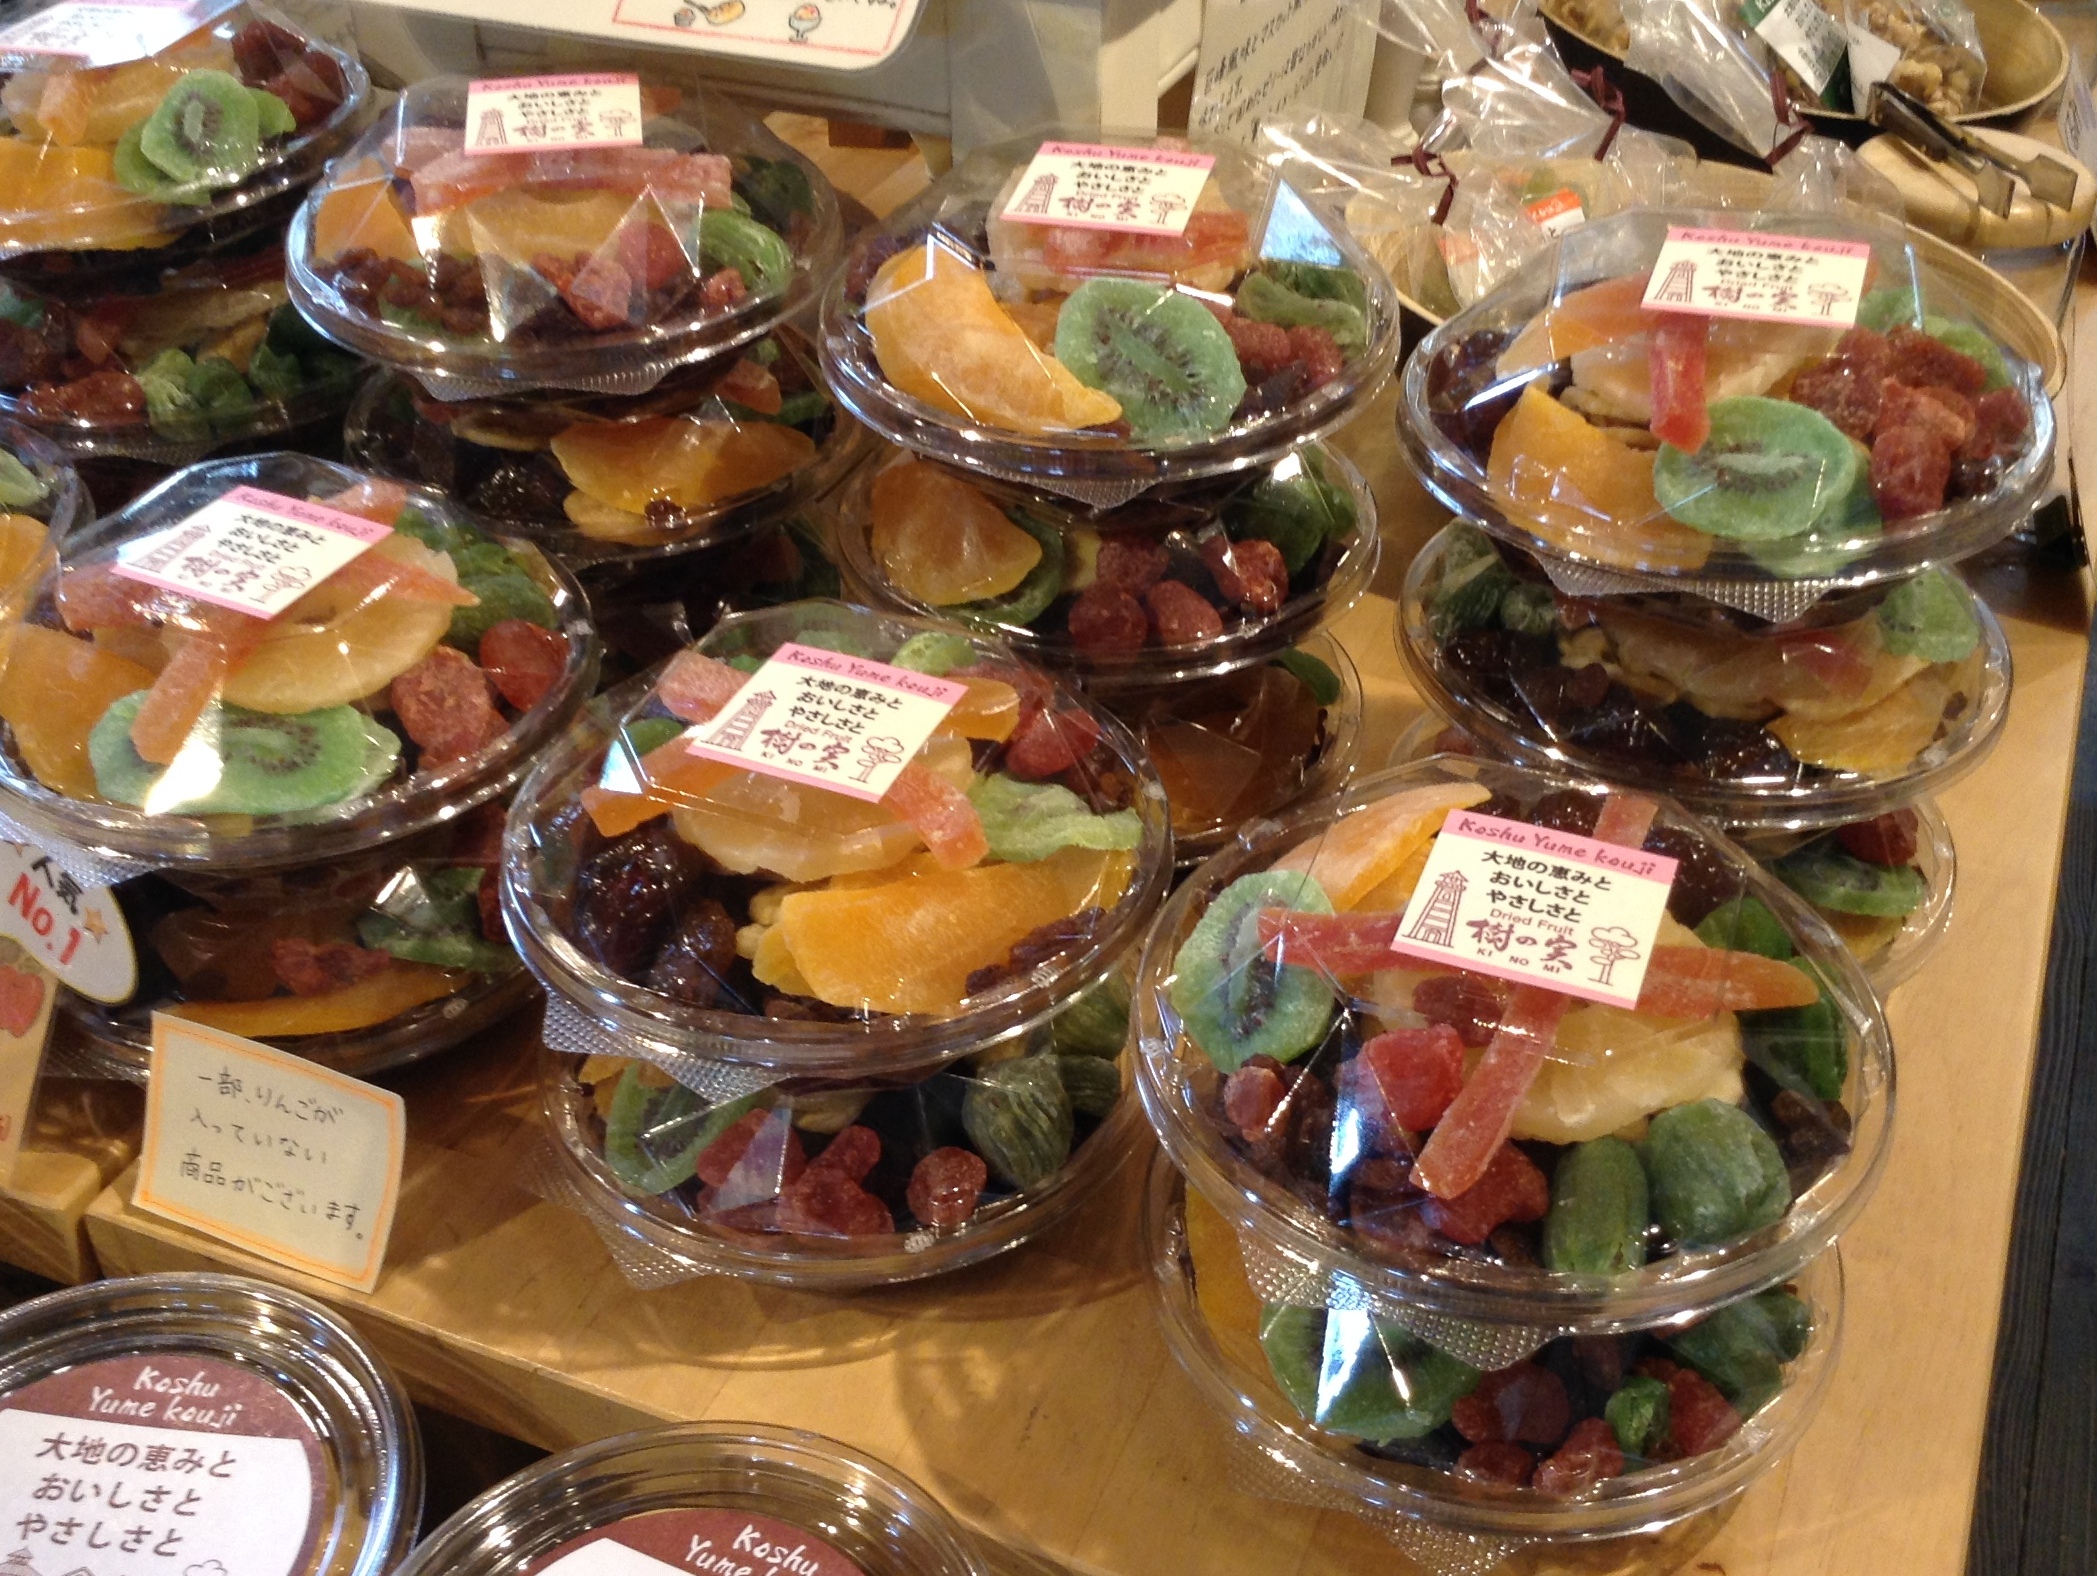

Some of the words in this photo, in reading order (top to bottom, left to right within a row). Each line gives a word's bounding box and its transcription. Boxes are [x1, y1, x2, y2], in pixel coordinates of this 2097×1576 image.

[787, 650, 843, 672] Koshu
[847, 662, 892, 683] Yume
[895, 674, 948, 698] kouji
[796, 675, 904, 710] 大地の恵みと
[788, 705, 866, 735] やさしさと
[796, 691, 880, 721] おいしさと
[1458, 817, 1526, 843] Koshu
[1533, 832, 1587, 858] Yume
[1592, 847, 1657, 876] kouji
[1480, 849, 1613, 892] 大地の恵みと
[1489, 870, 1590, 905] おいしさと
[8, 872, 82, 966] No.1
[1486, 889, 1583, 924] やさしさと
[1489, 908, 1533, 926] Dried
[1537, 919, 1576, 937] Fruit
[1466, 918, 1579, 970] 樹の実
[1476, 947, 1494, 958] KI
[1508, 956, 1530, 966] NO
[1542, 963, 1562, 975] MI
[198, 1065, 344, 1124] 一部、りんごが
[189, 1107, 327, 1164] 入っていない
[180, 1148, 364, 1240] 商品がございます。
[133, 1365, 222, 1398] Koshu
[88, 1386, 158, 1418] Yume
[162, 1396, 244, 1429] kouji
[35, 1431, 237, 1478] 大地の恵みと
[32, 1473, 202, 1517] おいしさと
[16, 1513, 184, 1557] やさしさと
[732, 1523, 820, 1576] Koshu
